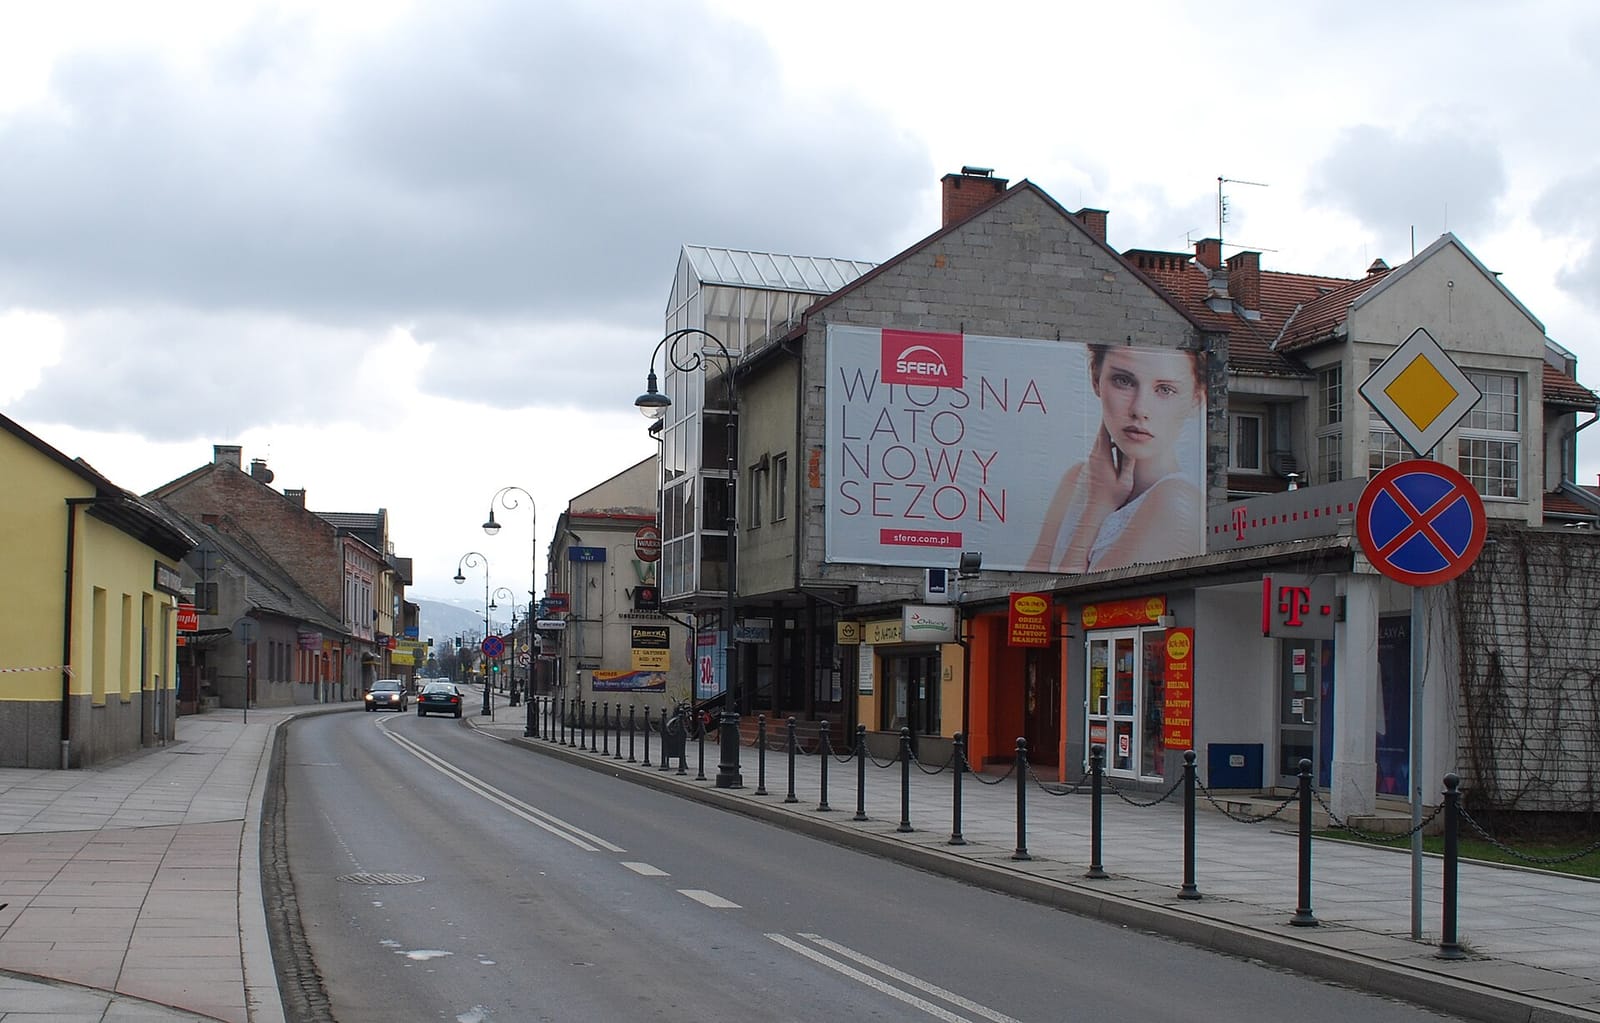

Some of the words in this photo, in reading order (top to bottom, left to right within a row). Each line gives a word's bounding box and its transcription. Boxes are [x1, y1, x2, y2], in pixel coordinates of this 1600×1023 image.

[896, 360, 949, 377] SFERA
[840, 366, 1048, 415] WIOSNA
[841, 404, 965, 446] LATO
[841, 442, 998, 486] NOWY
[839, 480, 1007, 524] SEZON
[893, 533, 950, 544] sfera.com.pl
[633, 629, 667, 639] FABRYKA
[1167, 681, 1189, 689] BIELIZNA
[1165, 699, 1190, 708] RAJSTOPY
[1164, 717, 1190, 726] SKARPETY
